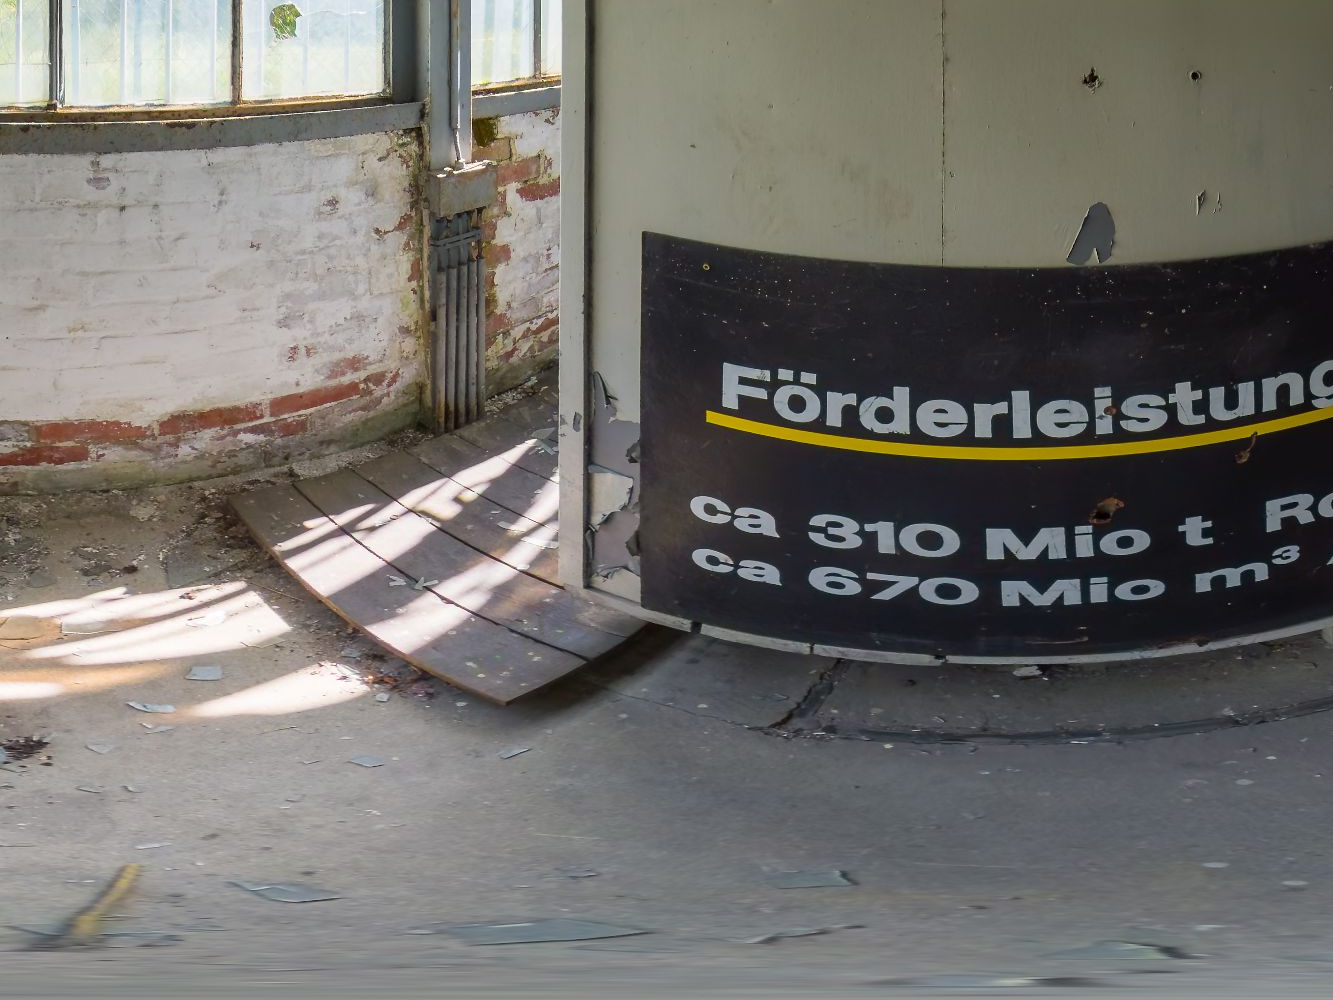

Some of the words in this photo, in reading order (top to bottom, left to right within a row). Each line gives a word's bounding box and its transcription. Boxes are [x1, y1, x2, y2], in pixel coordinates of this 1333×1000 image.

[689, 495, 781, 539] ca
[807, 513, 961, 558] 310
[985, 524, 1151, 560] Mio
[1178, 515, 1214, 546] t
[691, 548, 783, 587] ca
[808, 566, 980, 606] 670
[1000, 575, 1166, 607] Mio
